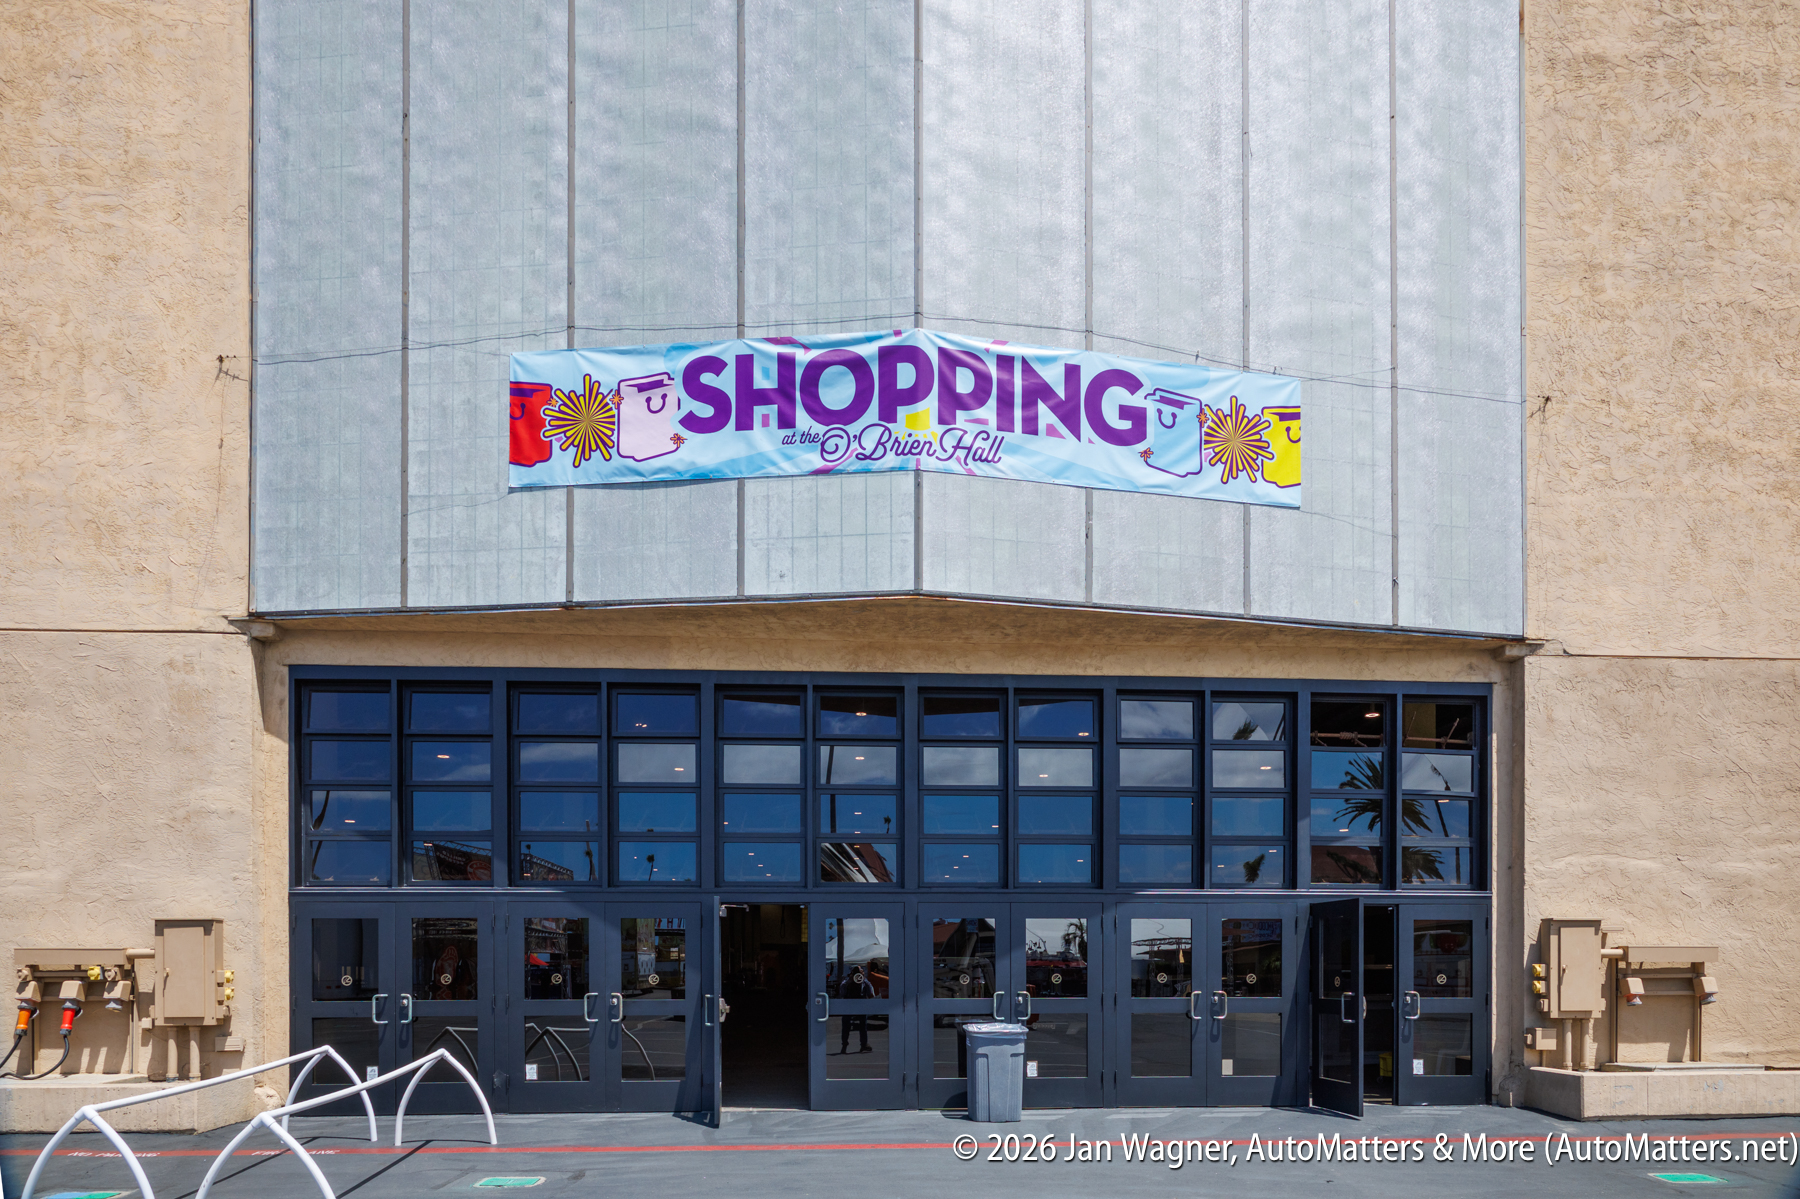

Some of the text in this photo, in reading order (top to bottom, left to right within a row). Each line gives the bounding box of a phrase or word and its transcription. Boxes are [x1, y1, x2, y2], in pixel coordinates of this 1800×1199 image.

[678, 344, 1147, 447] SHOPPING
[781, 422, 1003, 467] at the O'Brien Hall
